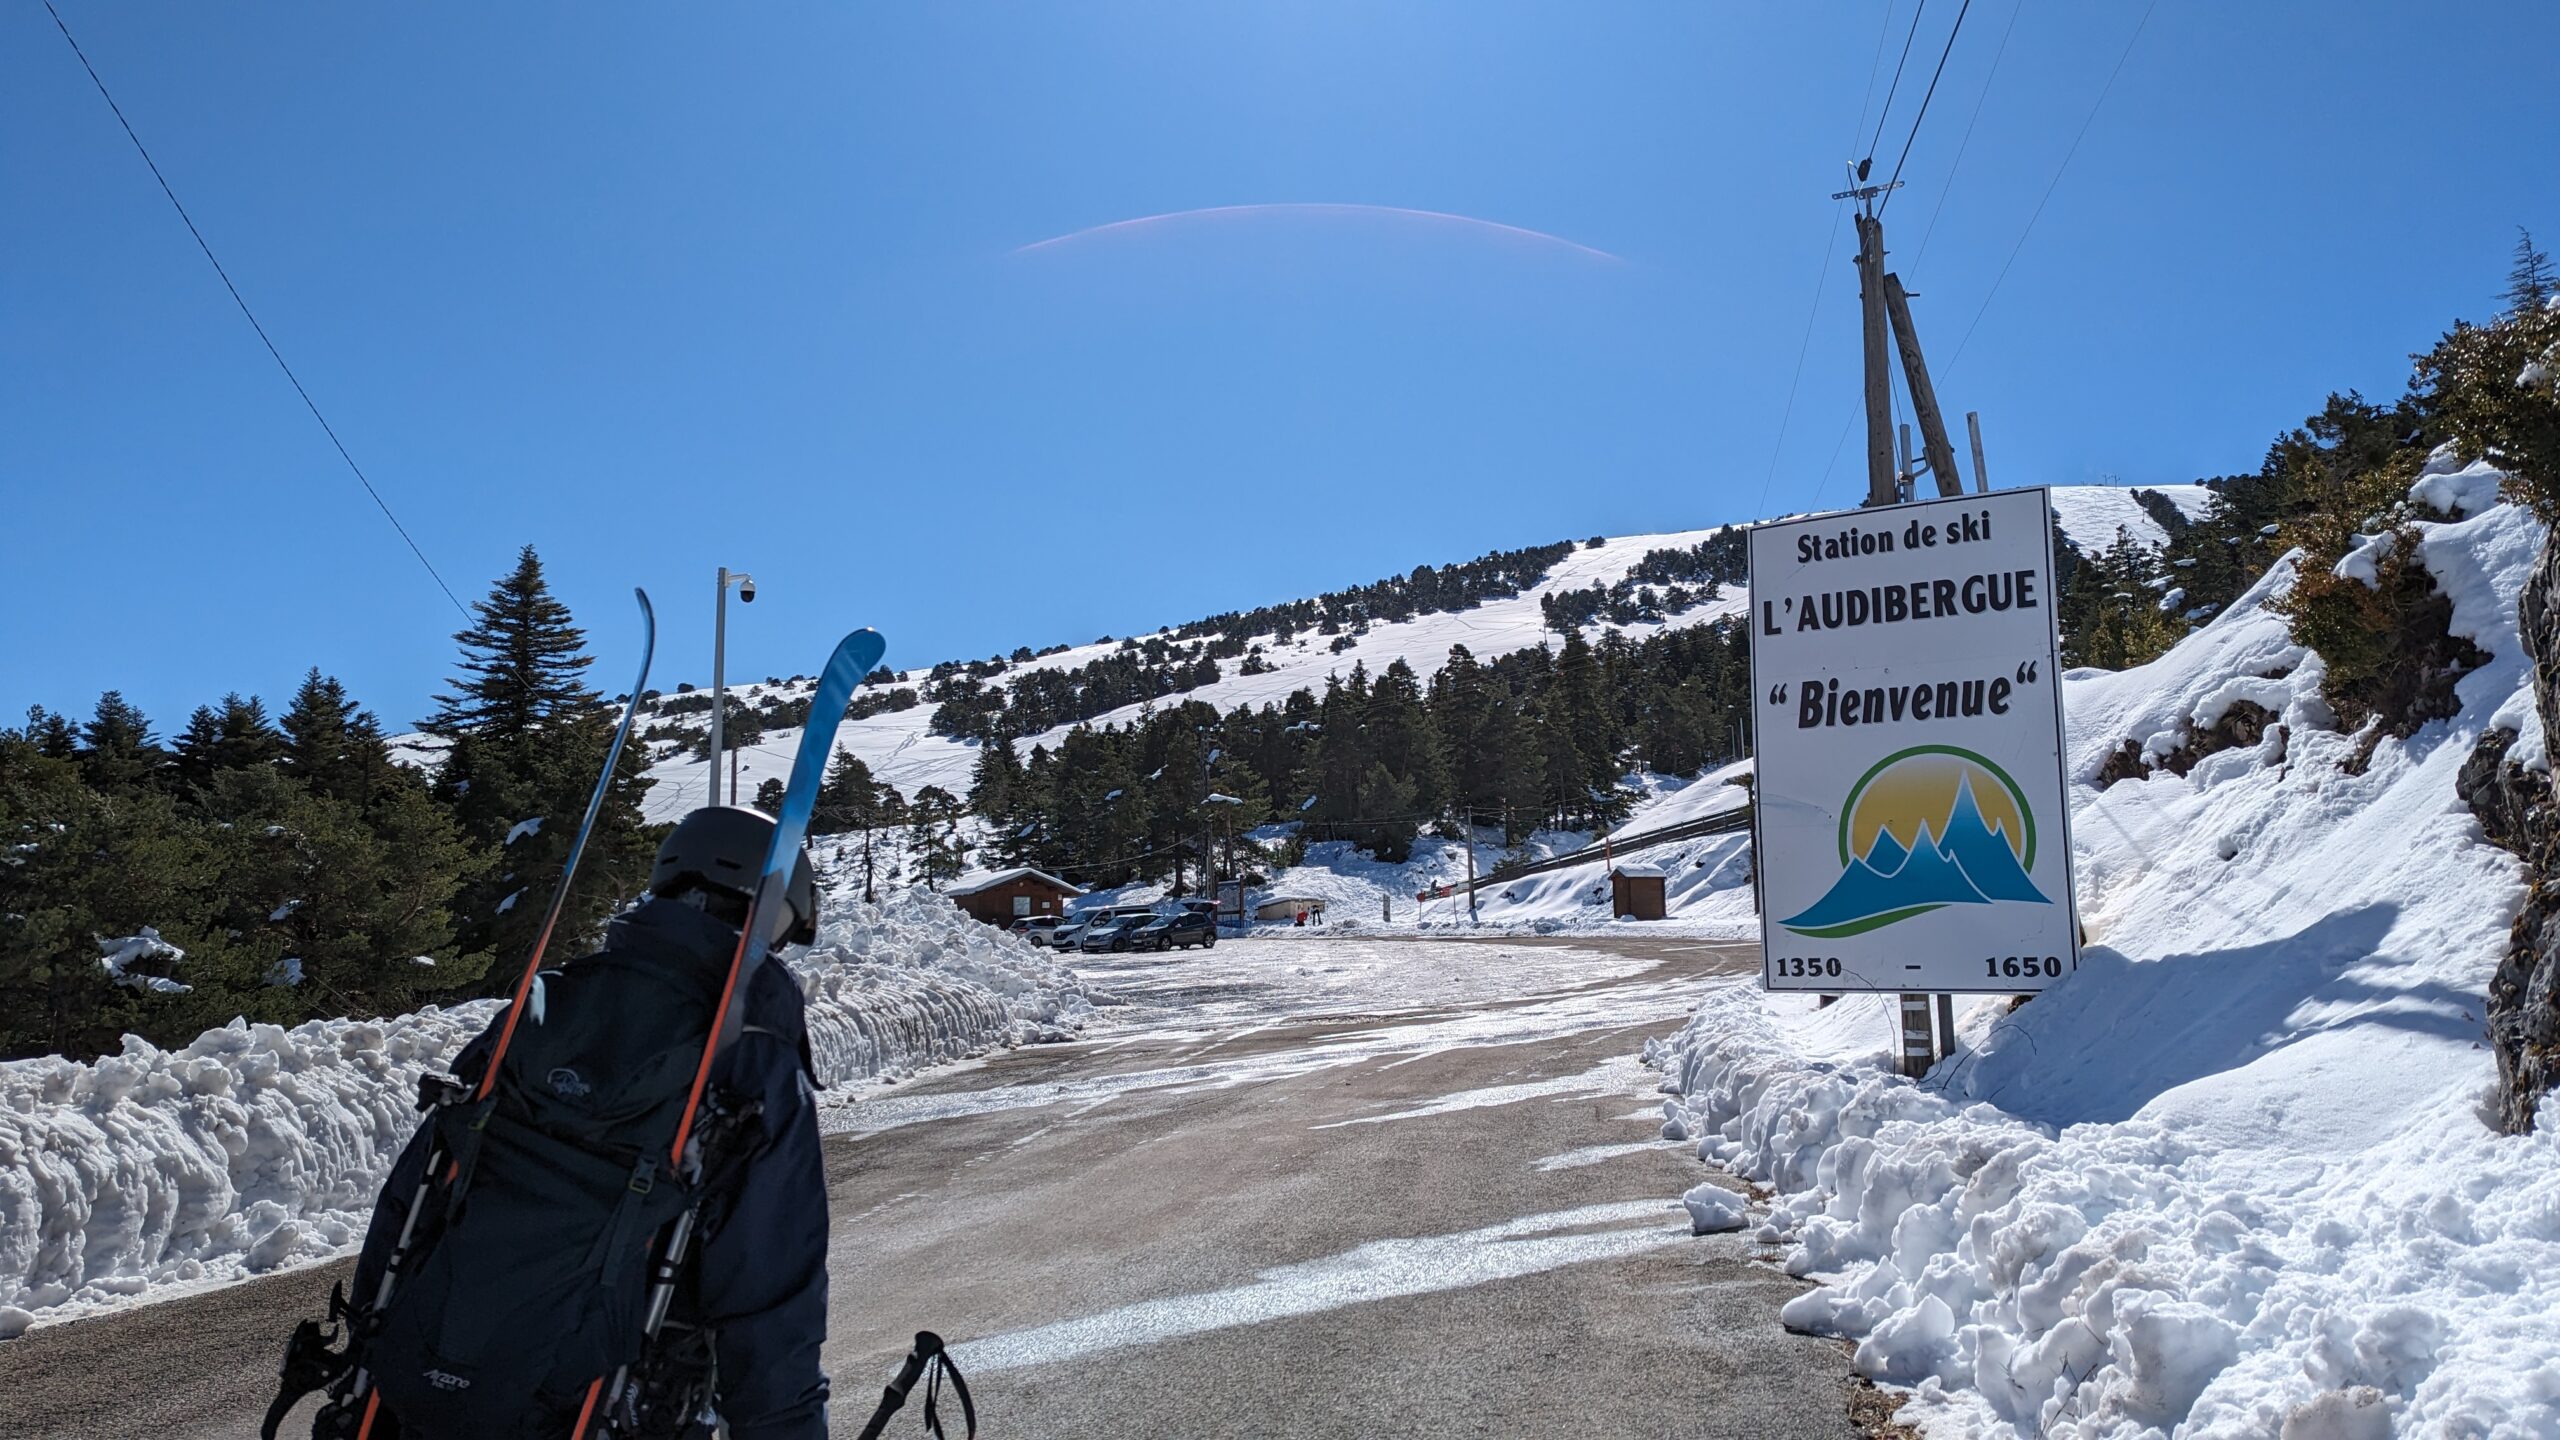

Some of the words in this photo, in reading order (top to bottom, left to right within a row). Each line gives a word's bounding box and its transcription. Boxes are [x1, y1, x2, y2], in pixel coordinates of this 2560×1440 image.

[1797, 527, 1894, 564] Station
[1903, 519, 1937, 550] de
[1946, 509, 1991, 545] ski
[1763, 569, 2038, 636] L’AUDIBERGUE
[1776, 957, 1842, 978] 1350
[1985, 956, 2062, 978] 1650
